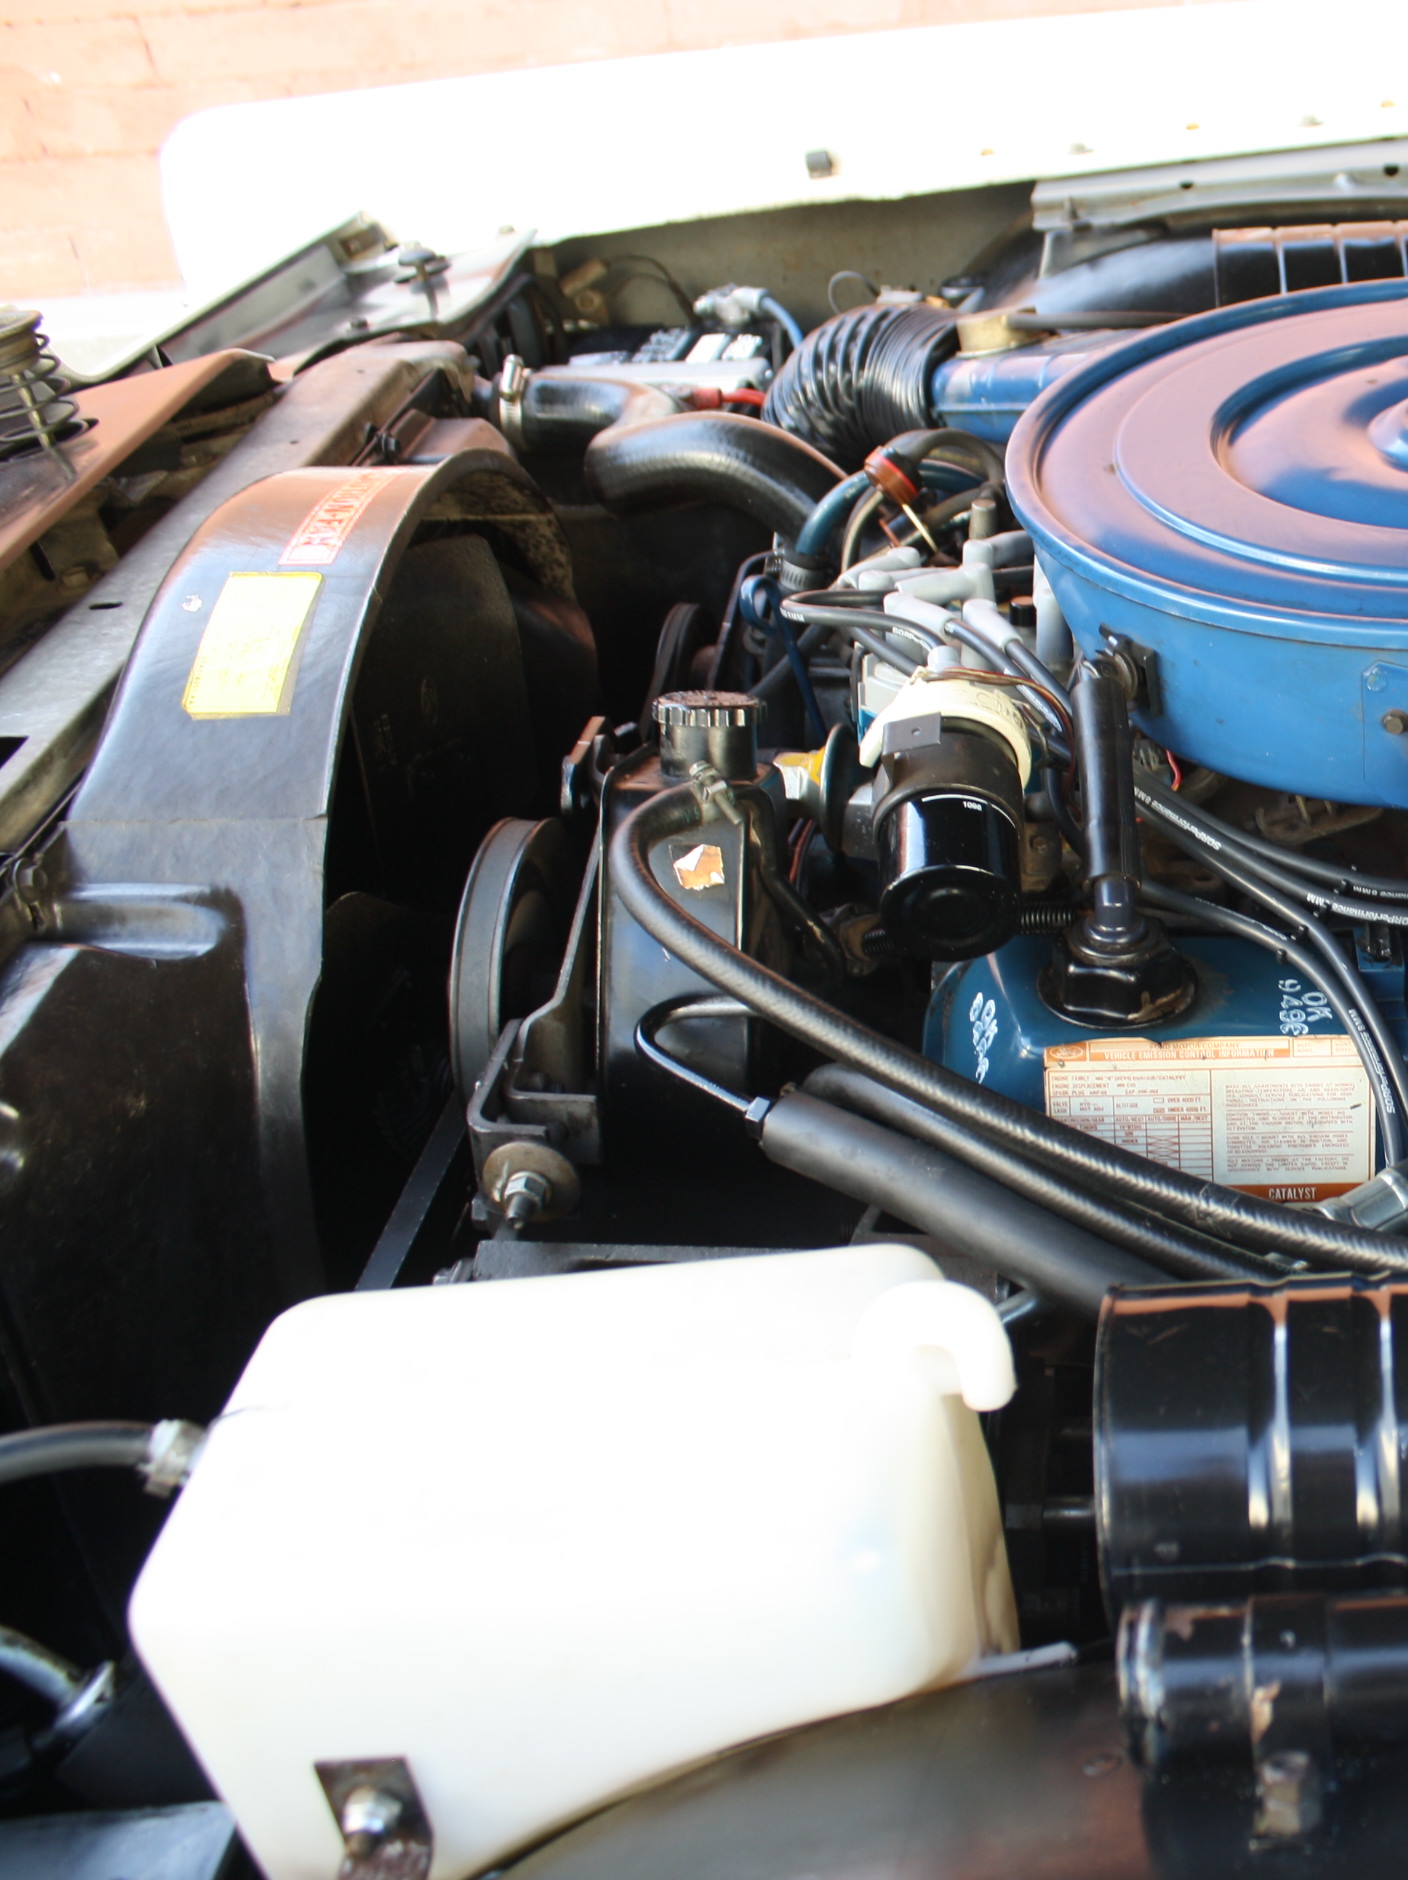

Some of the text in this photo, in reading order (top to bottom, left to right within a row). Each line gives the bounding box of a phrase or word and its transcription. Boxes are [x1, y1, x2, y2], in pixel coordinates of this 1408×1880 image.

[1104, 1049, 1274, 1060] VEHICLE EMISSION CONTROL INFORMATION
[1268, 1187, 1317, 1200] CATALYST
